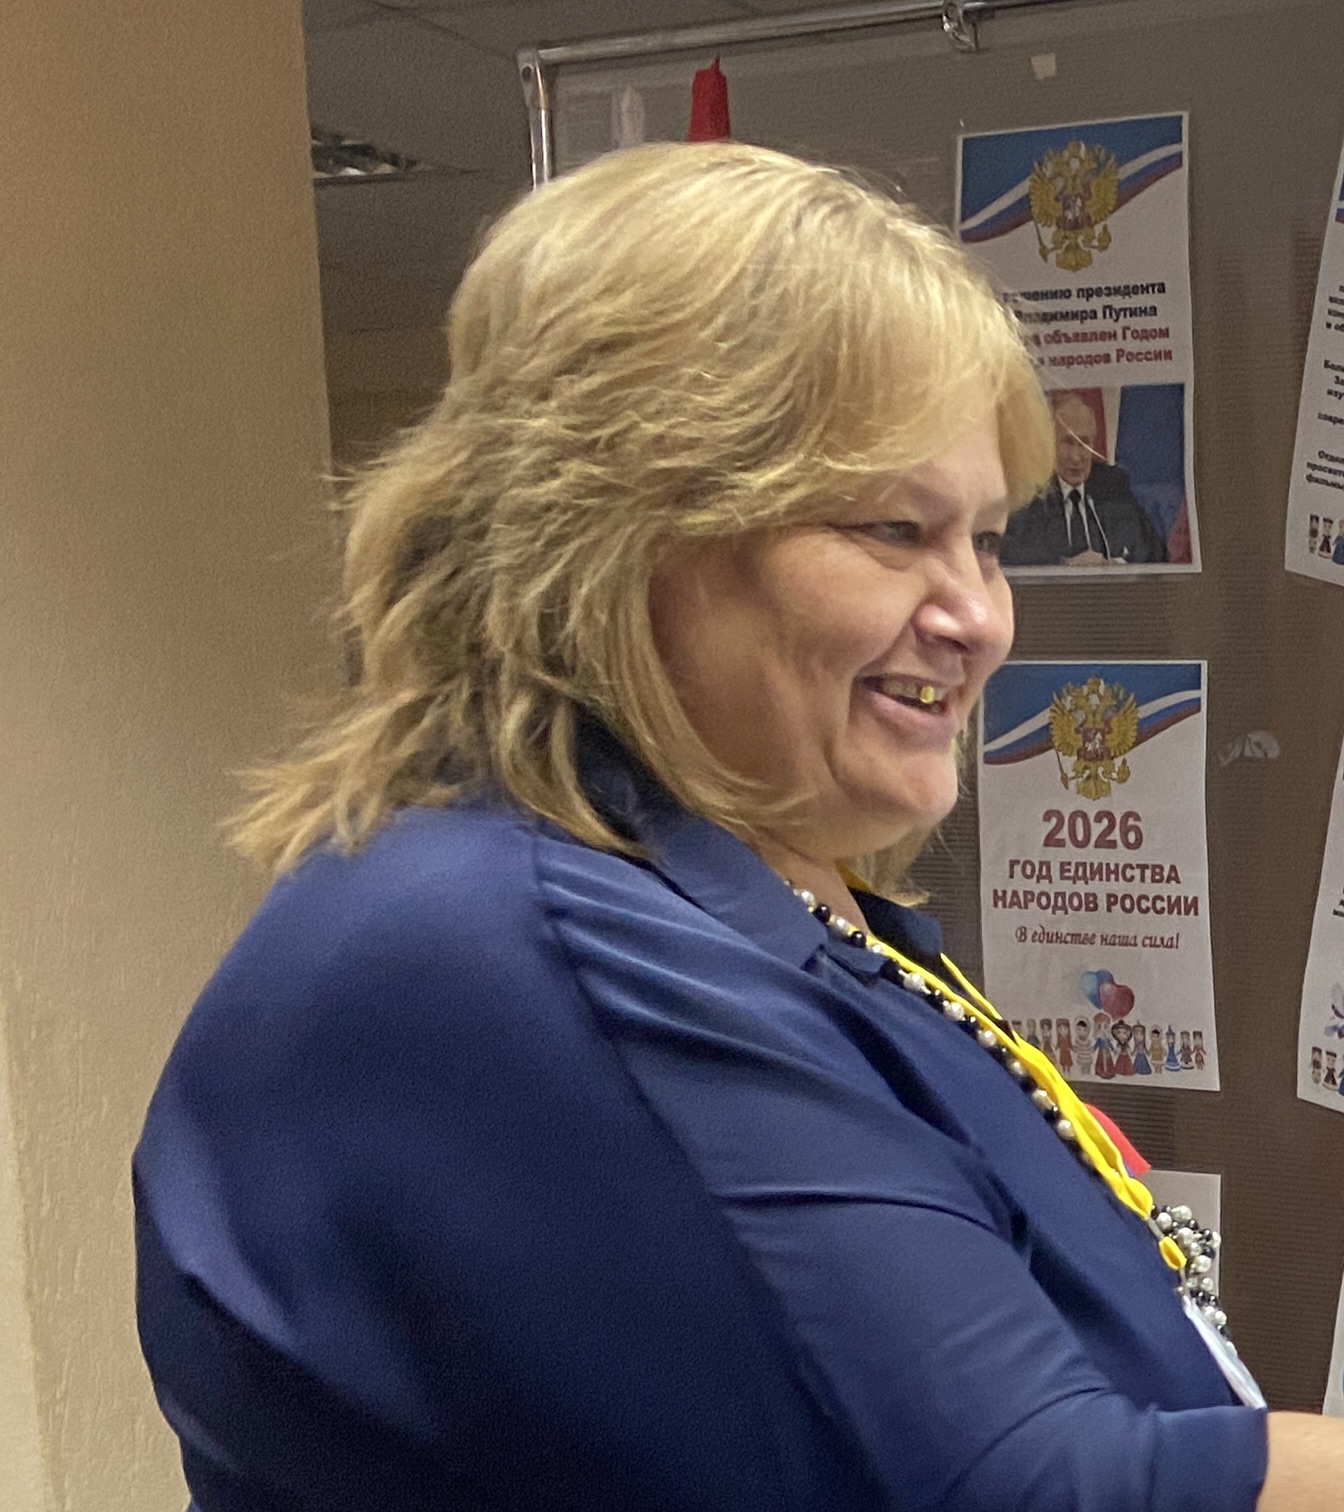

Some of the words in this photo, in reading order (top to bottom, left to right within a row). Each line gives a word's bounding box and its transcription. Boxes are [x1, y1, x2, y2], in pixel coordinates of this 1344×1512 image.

[1077, 282, 1165, 301] президента
[1103, 305, 1158, 322] Путина
[1122, 326, 1169, 342] Годом
[1116, 349, 1172, 362] России
[1042, 809, 1143, 850] 2026
[1009, 859, 1052, 884] ГОД
[1060, 861, 1181, 885] ЕДИНСТВА
[993, 889, 1098, 915] НАРОДОВ
[1106, 893, 1198, 916] РОССИИ
[1015, 926, 1027, 943] В
[1032, 925, 1096, 945] единстве
[1100, 934, 1138, 947] наша
[1142, 933, 1180, 949] сила!
